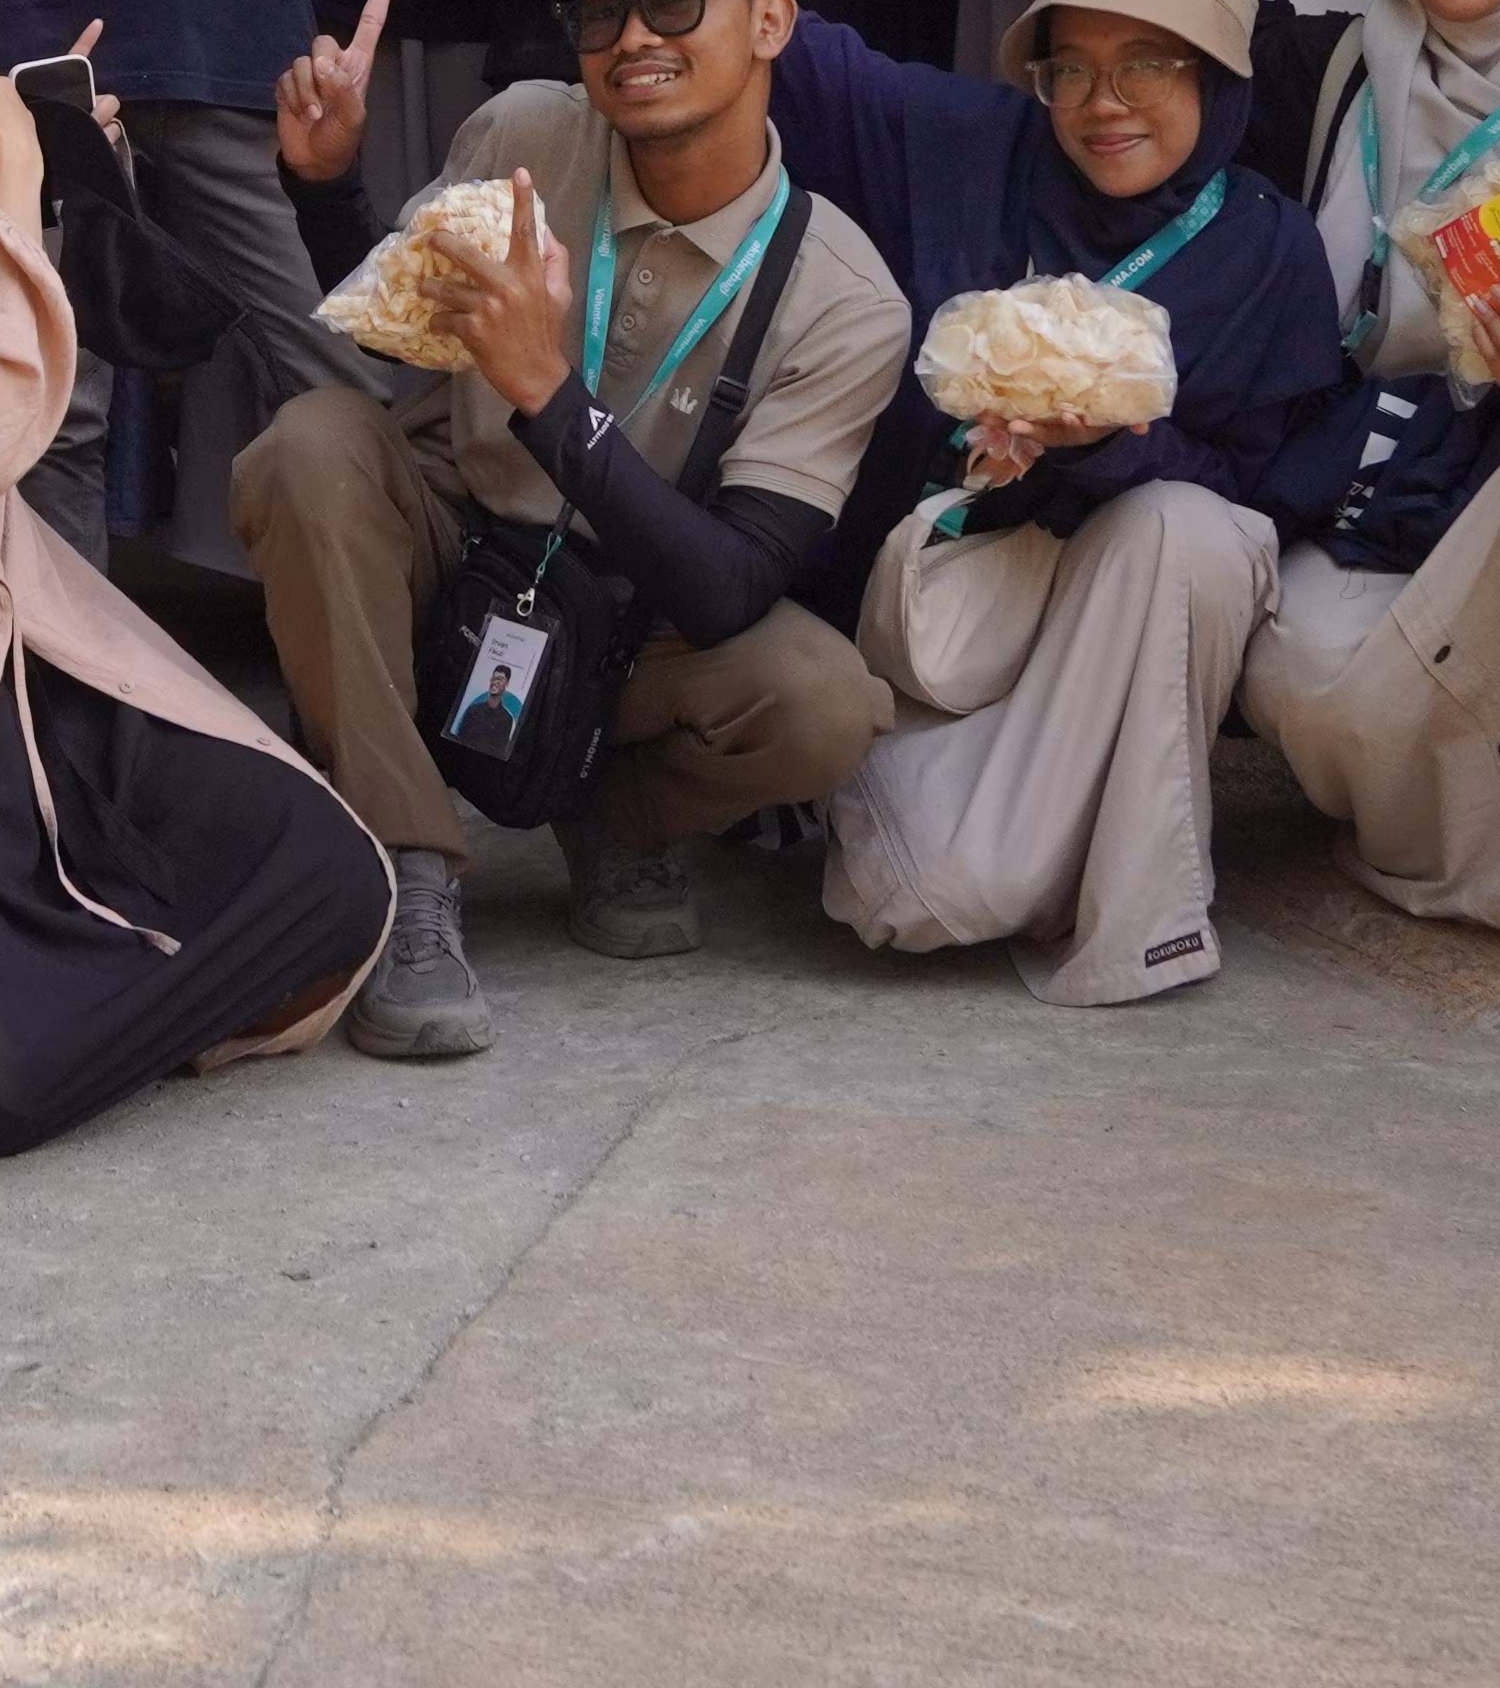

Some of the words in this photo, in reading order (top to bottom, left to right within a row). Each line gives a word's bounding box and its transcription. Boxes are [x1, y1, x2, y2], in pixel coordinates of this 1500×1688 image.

[719, 240, 761, 297] aksiberbagi
[592, 287, 606, 337] Volunteer
[673, 317, 707, 359] Volunteer
